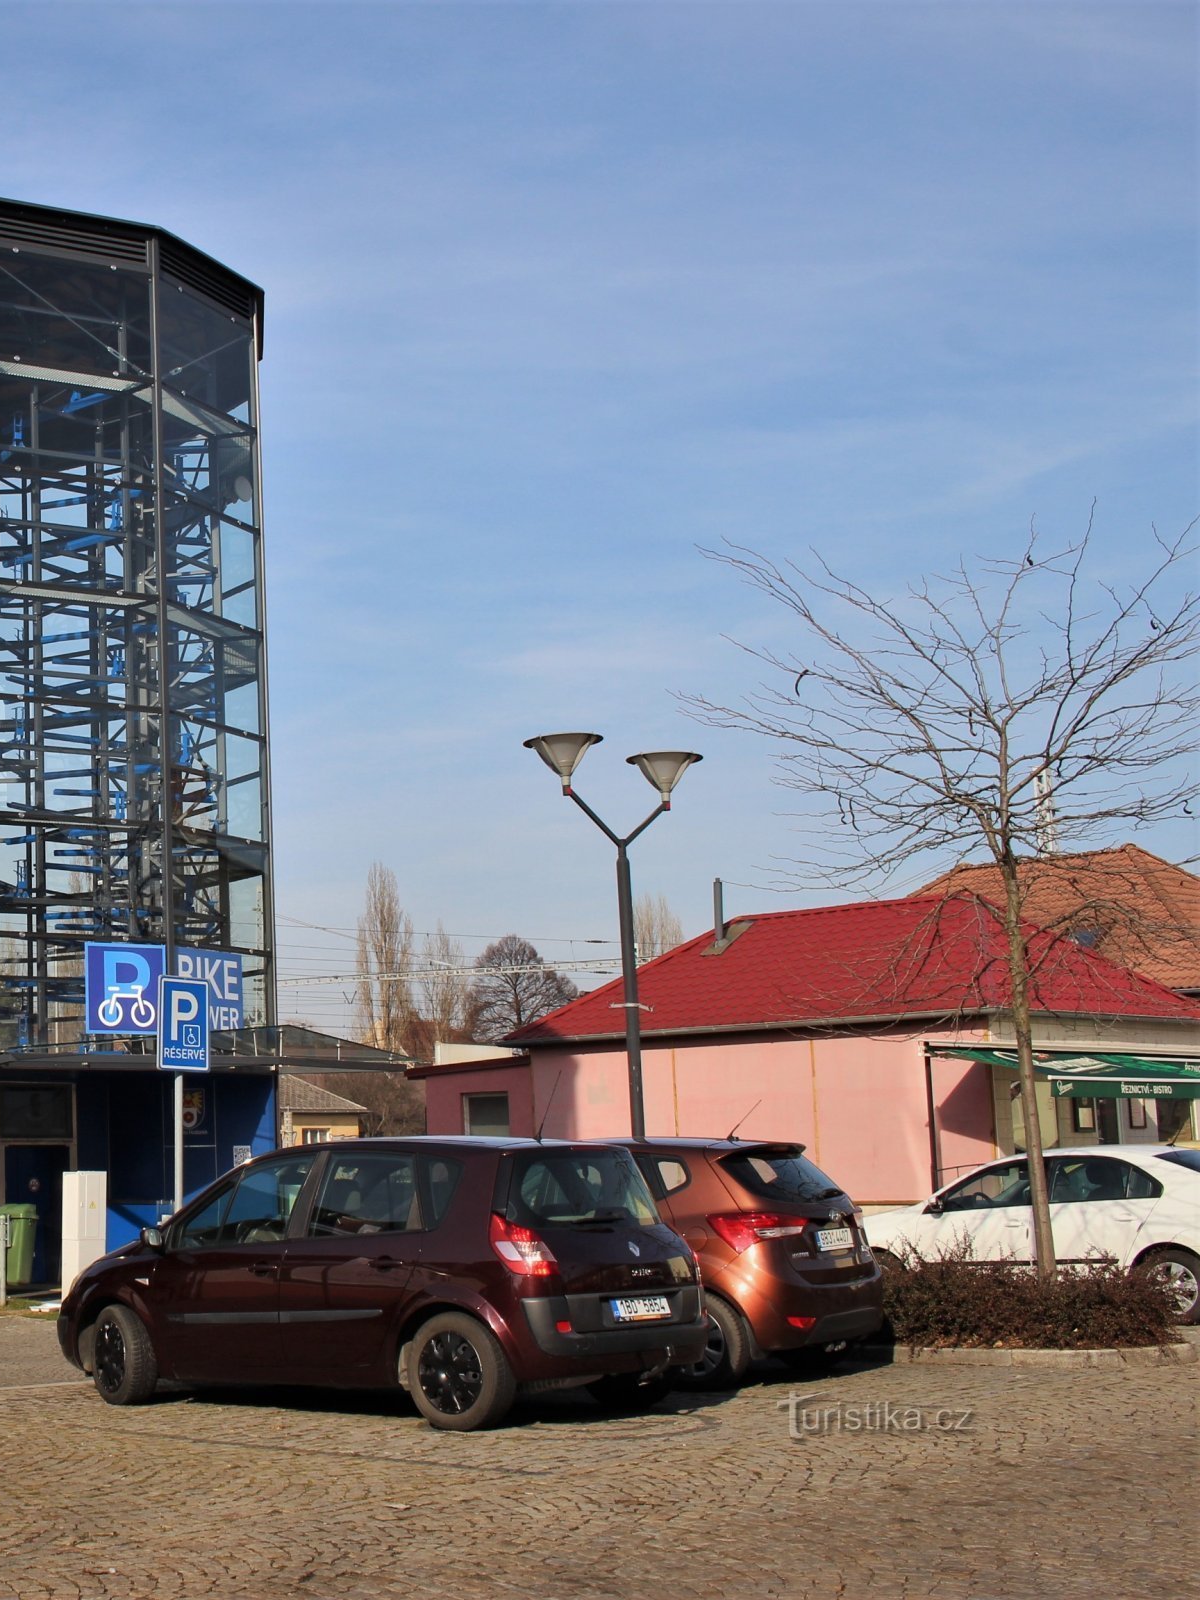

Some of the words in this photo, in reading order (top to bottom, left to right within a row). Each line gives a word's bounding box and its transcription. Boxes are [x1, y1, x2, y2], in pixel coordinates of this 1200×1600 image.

[104, 951, 150, 1020] P
[170, 990, 199, 1041] P
[164, 1046, 205, 1061] RÉSERVÉ
[1121, 1082, 1149, 1094] ŘEZNICTVÍ
[1153, 1084, 1172, 1094] BISTRO
